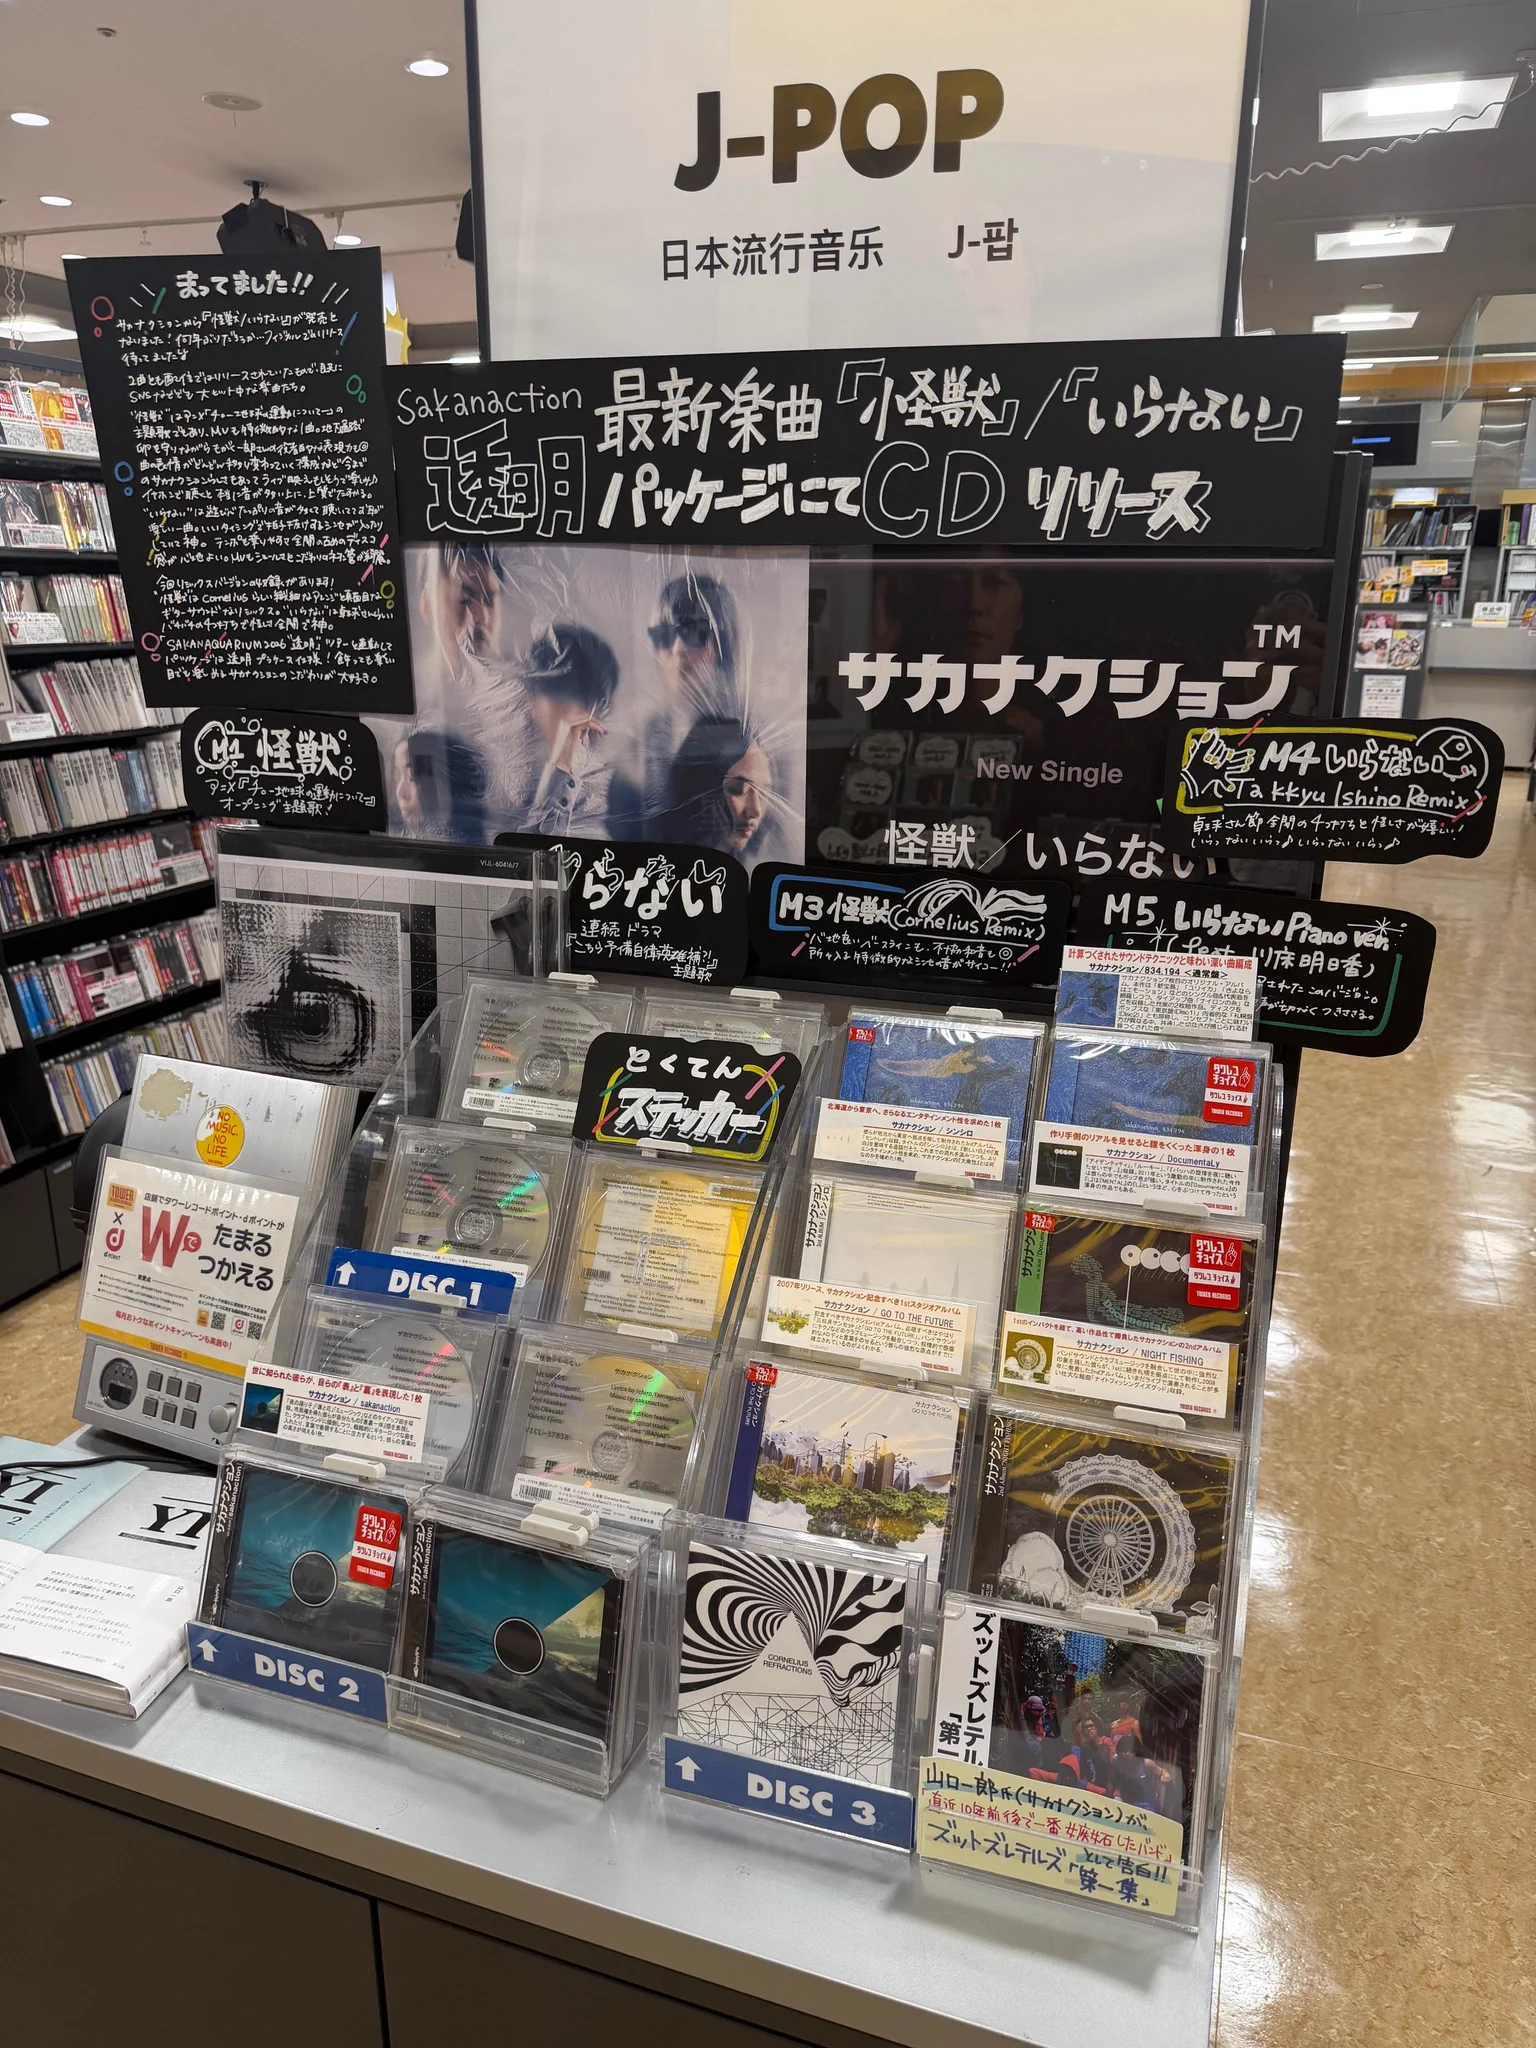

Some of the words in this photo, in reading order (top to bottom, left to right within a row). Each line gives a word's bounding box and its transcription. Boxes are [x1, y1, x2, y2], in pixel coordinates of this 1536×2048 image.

[674, 69, 1004, 192] J-POP
[948, 217, 1018, 261] J-팝
[662, 225, 883, 280] 日本流行音乐
[176, 270, 314, 299] まってました!!
[398, 382, 583, 425] Sakanaction
[1254, 624, 1300, 649] TM
[838, 652, 1299, 720] サカナクション
[257, 728, 340, 777] 怪獣
[1259, 741, 1320, 776] M4
[976, 757, 1033, 780] New
[1041, 761, 1124, 786] Single
[1335, 782, 1401, 807] Ishino
[1407, 785, 1469, 809] Remix
[580, 919, 662, 938] 連続ドラマ
[779, 892, 824, 920] M3
[826, 892, 891, 925] 怪獣
[985, 917, 1045, 941] Remix)
[1104, 893, 1158, 926] M5
[1174, 901, 1284, 937] いらない
[1287, 912, 1347, 947] Piano
[1068, 949, 1252, 970] 計算つくされたサウンドテクニックと味わい深い曲編成
[671, 964, 712, 982] 主題歌
[627, 1046, 742, 1080] とくてん
[1213, 1063, 1239, 1076] タワレコ
[1213, 1074, 1238, 1087] チョイス
[1210, 1091, 1225, 1100] タワレコ
[1226, 1092, 1242, 1102] チョイス
[206, 1120, 239, 1136] MUSIC.
[218, 1111, 231, 1122] NO
[614, 1087, 766, 1143] ステッカー
[213, 1134, 226, 1145] NO
[892, 1121, 936, 1132] サカナクション
[946, 1127, 973, 1137] シンシロ
[207, 1144, 228, 1158] LIFE.
[1050, 1130, 1235, 1156] 作り手側のリアルを見せると腹をくくった渾身の1枚
[1106, 1148, 1156, 1160] サカナクション
[1167, 1155, 1220, 1168] DocumentaLy
[805, 1184, 822, 1248] サカナクション
[142, 1205, 192, 1268] W
[213, 1223, 272, 1257] たまる
[1195, 1239, 1225, 1254] タワレコ
[1195, 1251, 1224, 1266] チョイス
[198, 1254, 274, 1291] つかえる
[1194, 1272, 1211, 1281] タワレコ
[1213, 1273, 1230, 1283] チョイス
[469, 1282, 483, 1306] 1
[1197, 1291, 1212, 1299] TOWER
[1213, 1292, 1231, 1300] RECORDS
[824, 1300, 870, 1314] サカナクション
[881, 1310, 893, 1318] GO
[895, 1311, 905, 1320] TO
[908, 1312, 922, 1323] THE
[925, 1315, 953, 1328] FUTURE
[1077, 1340, 1129, 1354] サカナクション
[1141, 1349, 1165, 1360] NIGHT
[1170, 1353, 1203, 1366] FISHING
[309, 1390, 350, 1403] サカナクション
[361, 1400, 400, 1413] sakanaction
[985, 1415, 1004, 1496] サカナクション
[216, 1463, 236, 1534] サカナクション
[363, 1512, 387, 1528] タワレコ
[361, 1526, 385, 1543] チョイス
[356, 1546, 372, 1557] タワレコ
[373, 1549, 388, 1561] チョイス
[409, 1523, 426, 1596] サカナクション
[762, 1660, 813, 1676] REFRACTIONS
[767, 1653, 809, 1668] CORNELIUS
[255, 1653, 325, 1692] DISC
[337, 1677, 360, 1702] 2
[747, 1772, 833, 1817] DISC
[850, 1800, 876, 1826] 3
